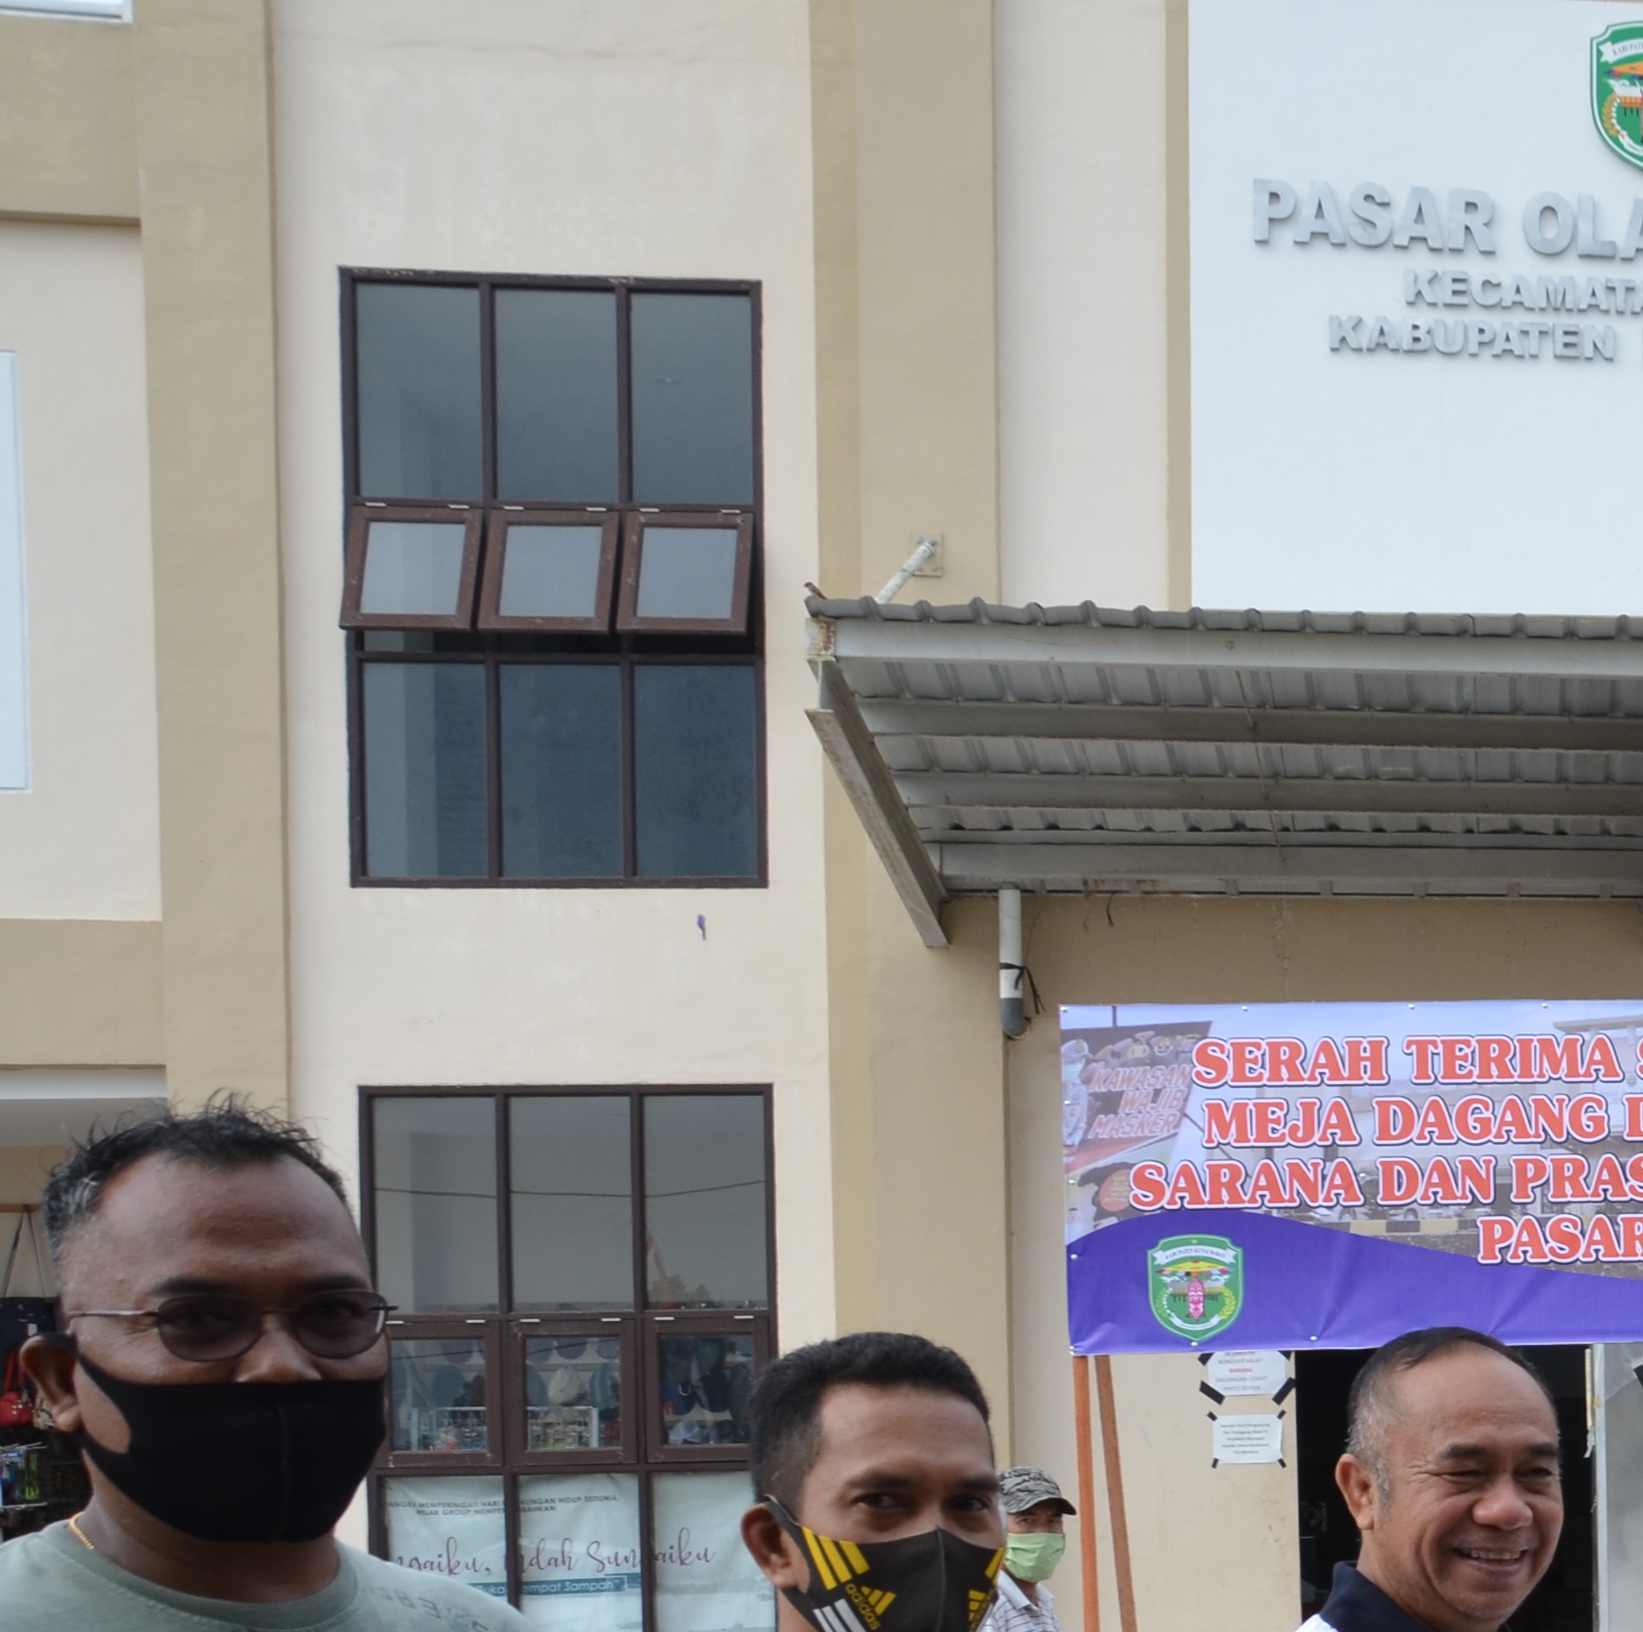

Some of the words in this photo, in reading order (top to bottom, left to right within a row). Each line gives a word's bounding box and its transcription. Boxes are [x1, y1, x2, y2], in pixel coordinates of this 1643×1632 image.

[1252, 178, 1496, 254] PASAR
[1327, 314, 1616, 362] KABUPATEN
[1088, 1064, 1194, 1093] KAWASAN
[1192, 1037, 1388, 1087] SERAH
[1403, 1034, 1623, 1083] TERIMA
[1087, 1111, 1180, 1139] MASKER
[1119, 1087, 1188, 1115] WAJIB
[1203, 1098, 1360, 1147] MEJA
[1373, 1093, 1609, 1144] DAGANG
[1130, 1158, 1364, 1210] SARANA
[1377, 1156, 1496, 1205] DAN
[586, 1526, 717, 1573] Sunaiku
[844, 1583, 880, 1631] adidas
